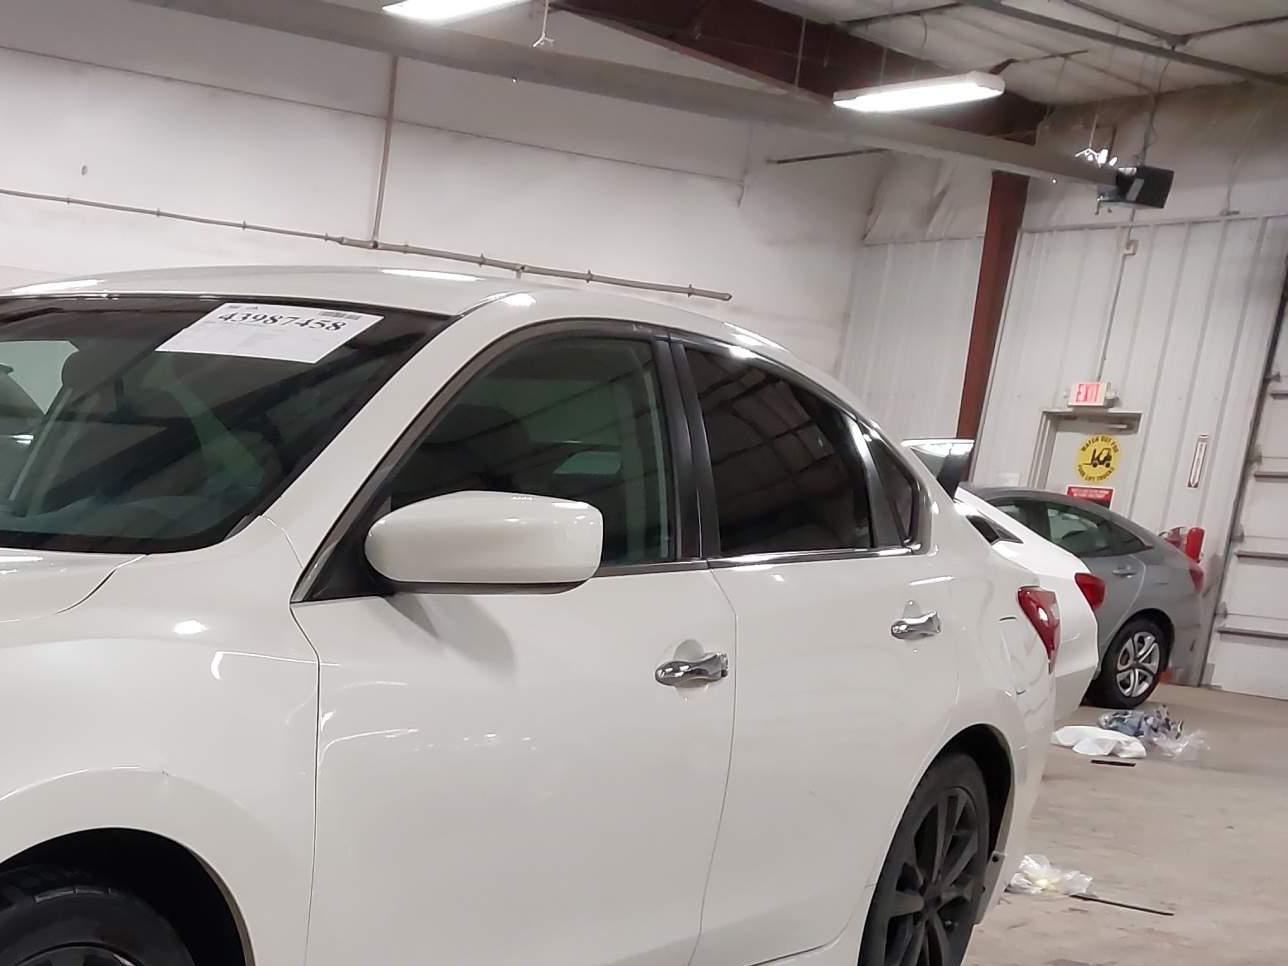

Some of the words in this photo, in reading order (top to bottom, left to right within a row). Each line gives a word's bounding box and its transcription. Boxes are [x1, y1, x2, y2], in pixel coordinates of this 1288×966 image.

[218, 312, 346, 331] 43987458
[1075, 383, 1100, 402] EXIT
[1081, 436, 1099, 451] WATCH
